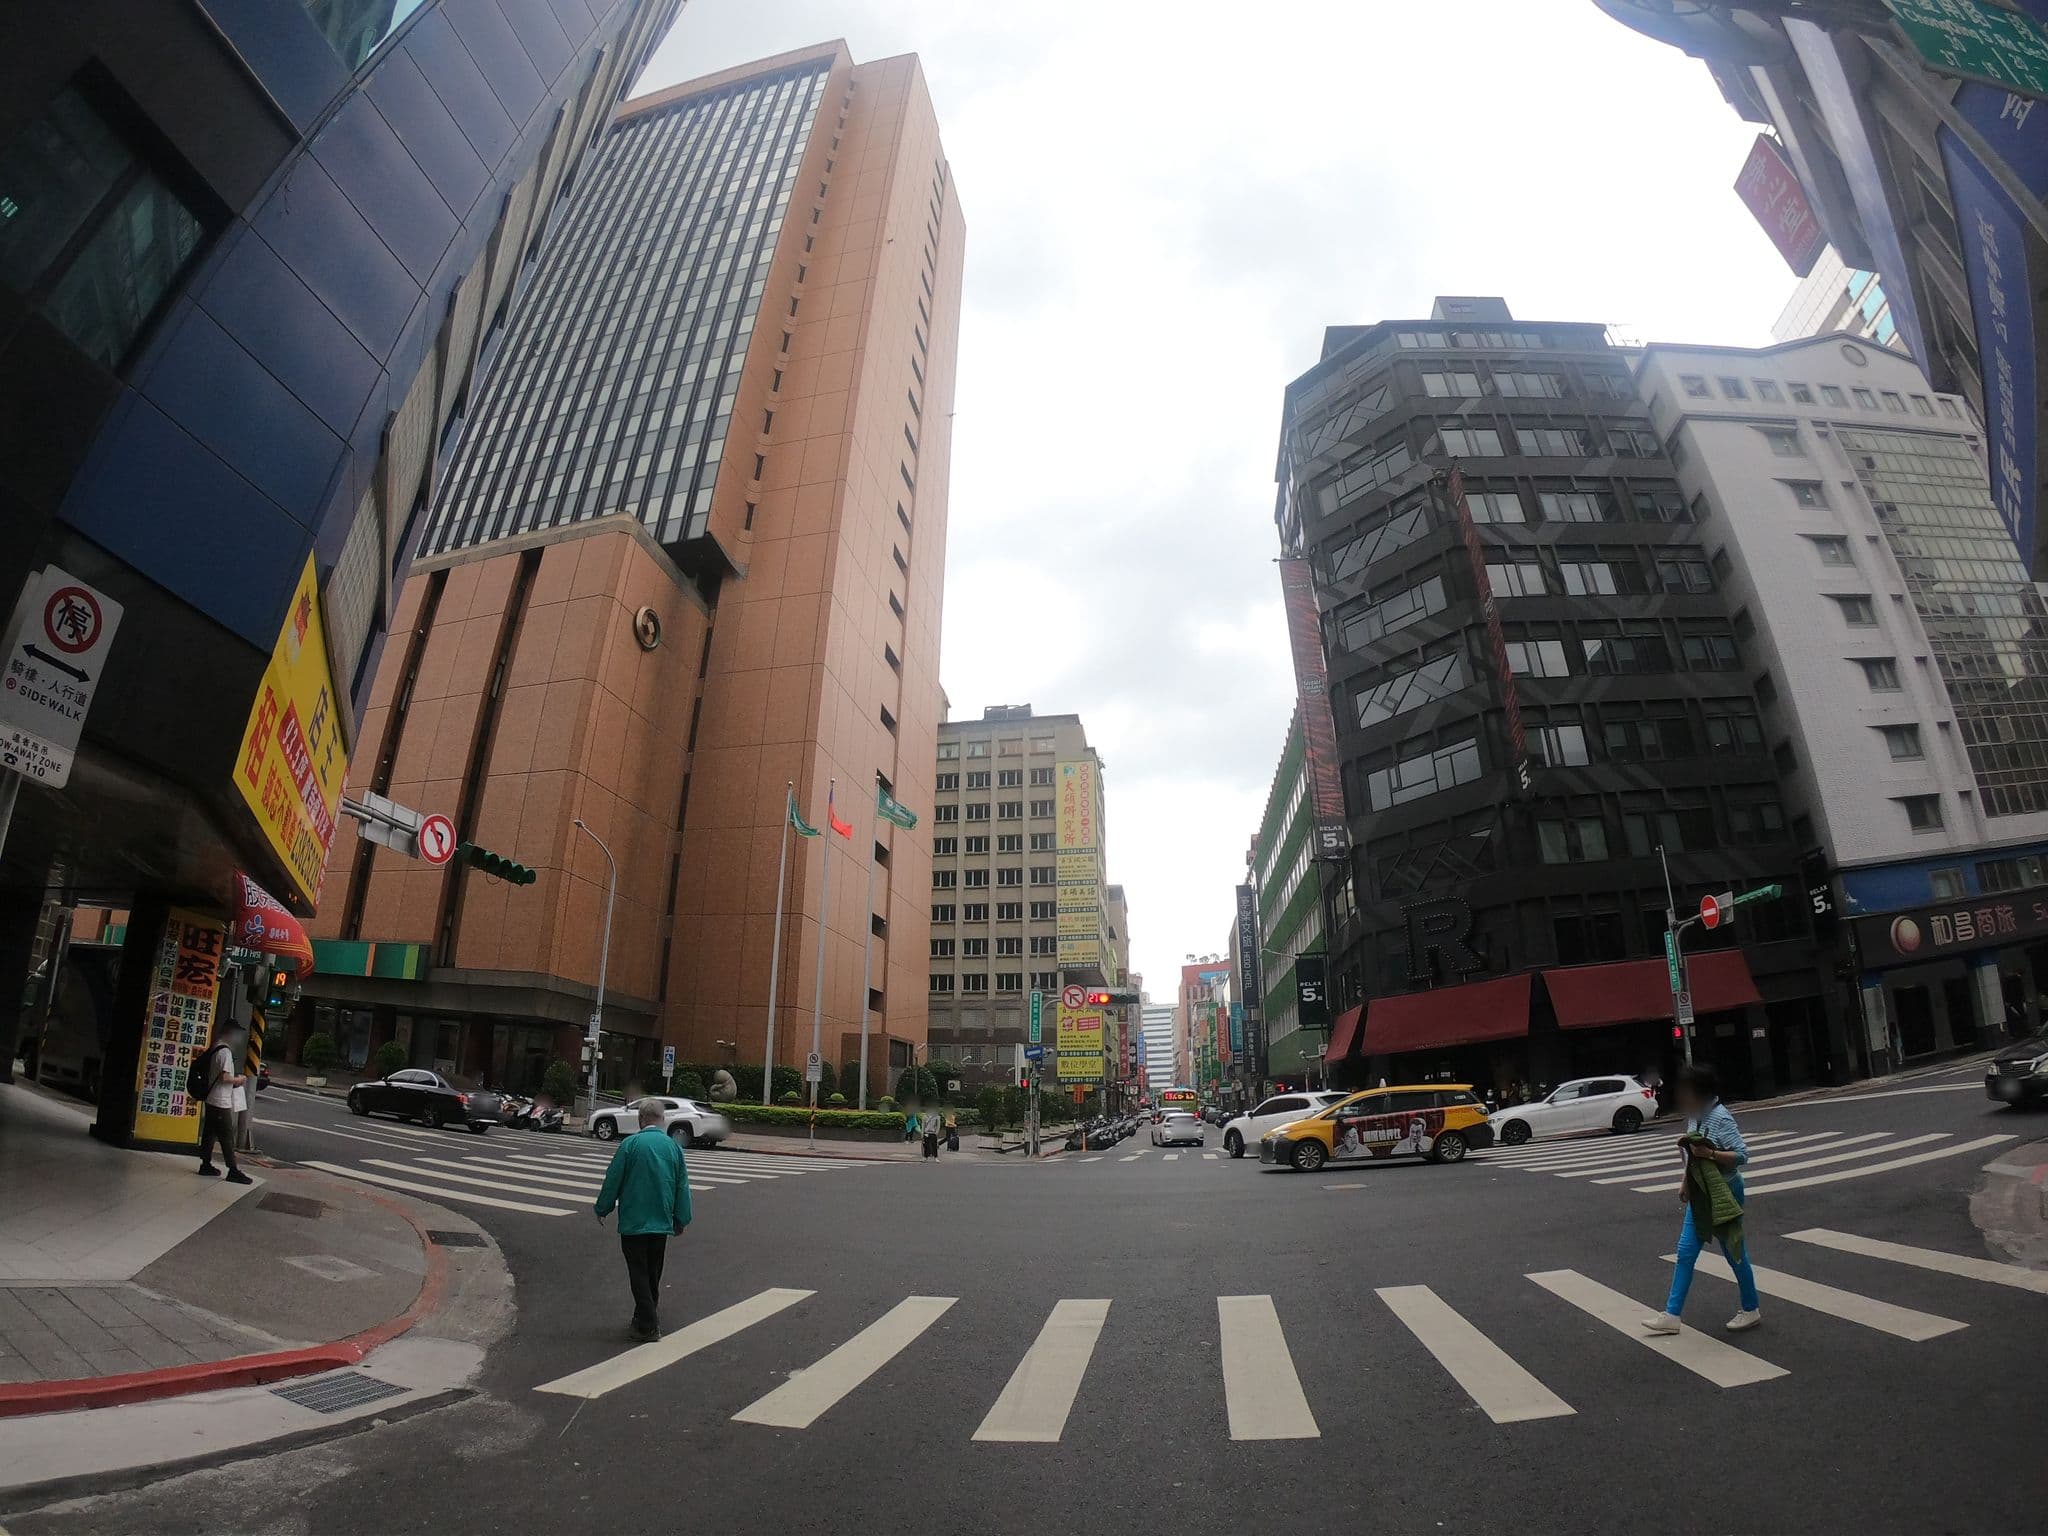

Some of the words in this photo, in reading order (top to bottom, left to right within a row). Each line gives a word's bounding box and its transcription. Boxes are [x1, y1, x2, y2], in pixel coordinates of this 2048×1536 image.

[19, 684, 82, 722] SIDEWALK
[24, 761, 45, 778] 110
[39, 756, 62, 773] ZONE
[1322, 832, 1338, 848] 5
[1809, 884, 1828, 896] RELAX
[1812, 895, 1826, 914] 5
[1930, 905, 2018, 946] 和昌商旅
[275, 972, 286, 986] 19
[1302, 987, 1317, 1002] 5
